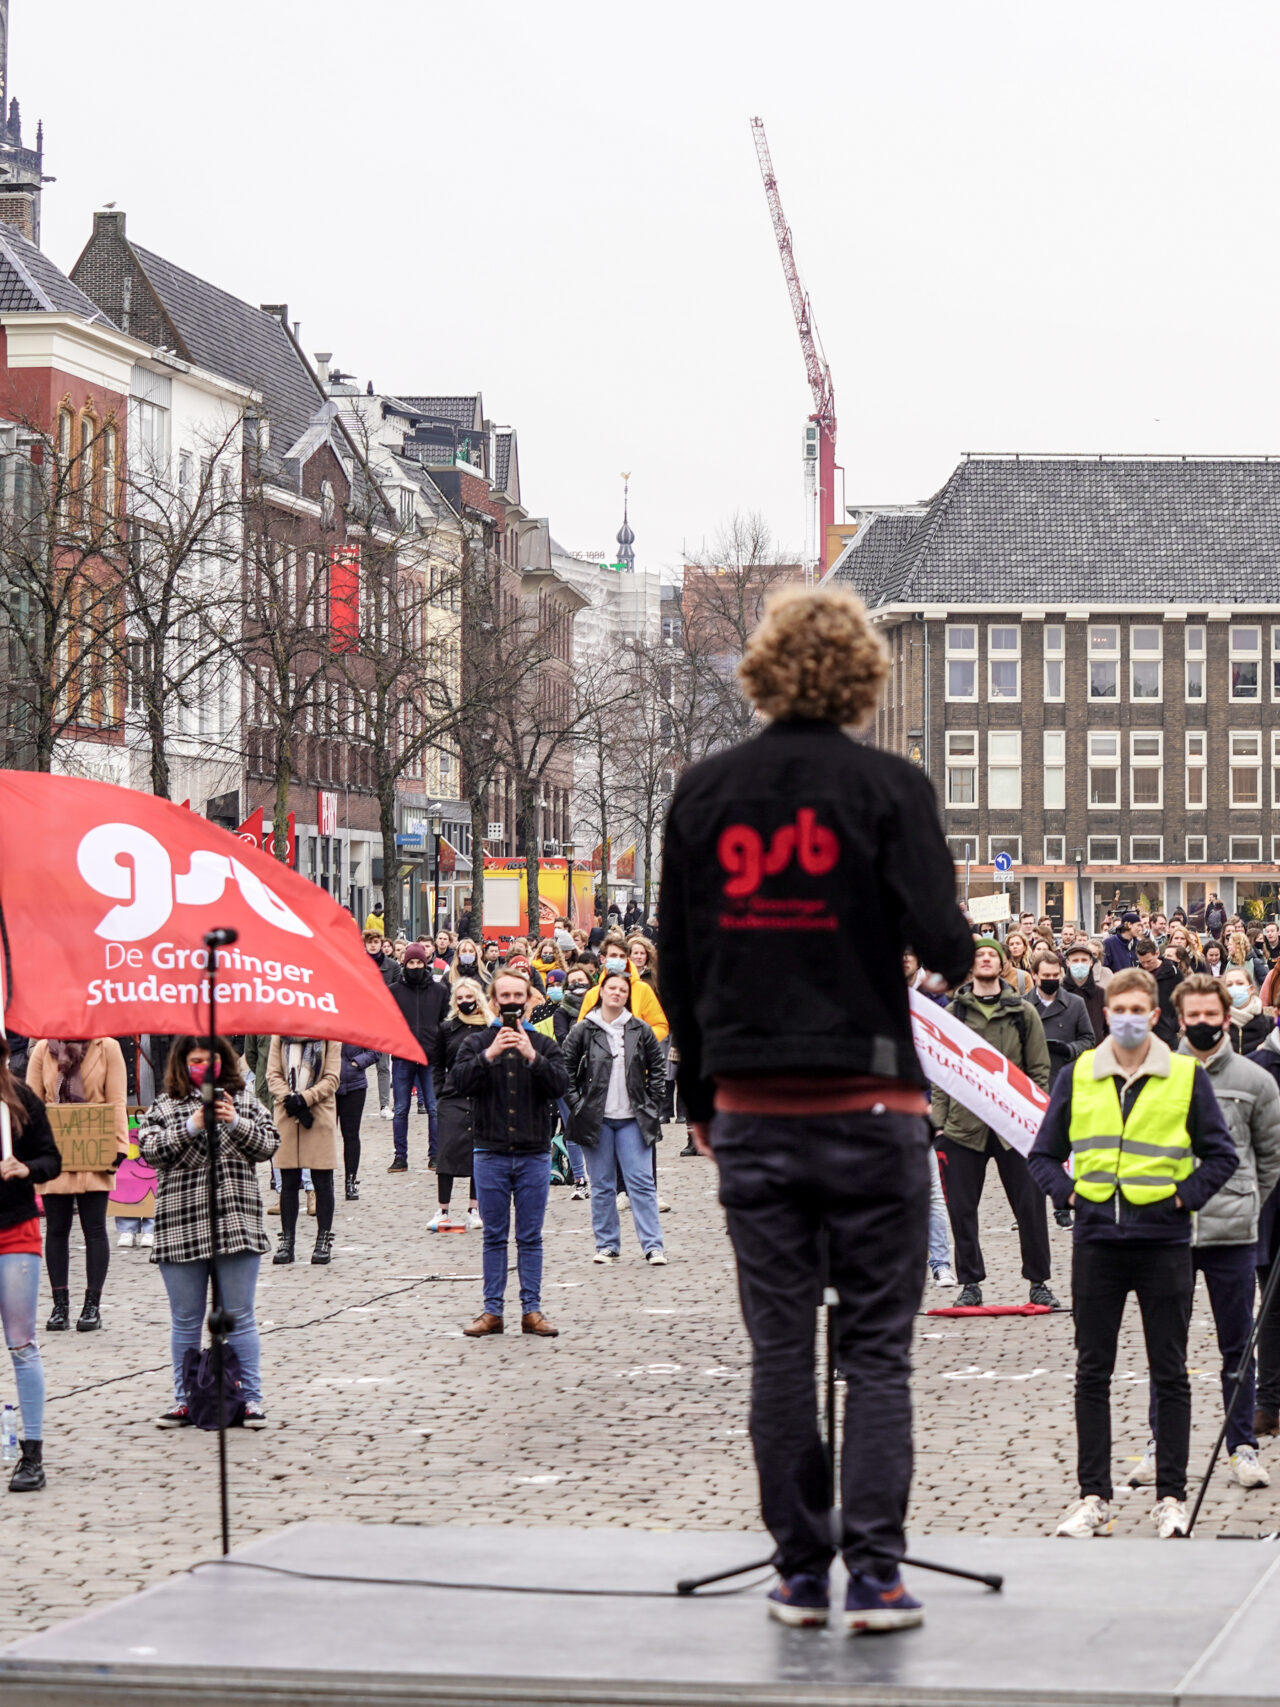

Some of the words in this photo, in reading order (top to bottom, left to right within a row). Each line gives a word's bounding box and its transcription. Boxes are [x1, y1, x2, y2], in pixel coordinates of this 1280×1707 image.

[717, 807, 840, 899] gsb
[104, 942, 144, 970] De
[151, 941, 315, 985] Groninger
[85, 974, 339, 1015] Studentenbond
[57, 1107, 114, 1137] WAPPIE
[72, 1138, 111, 1166] MOE
